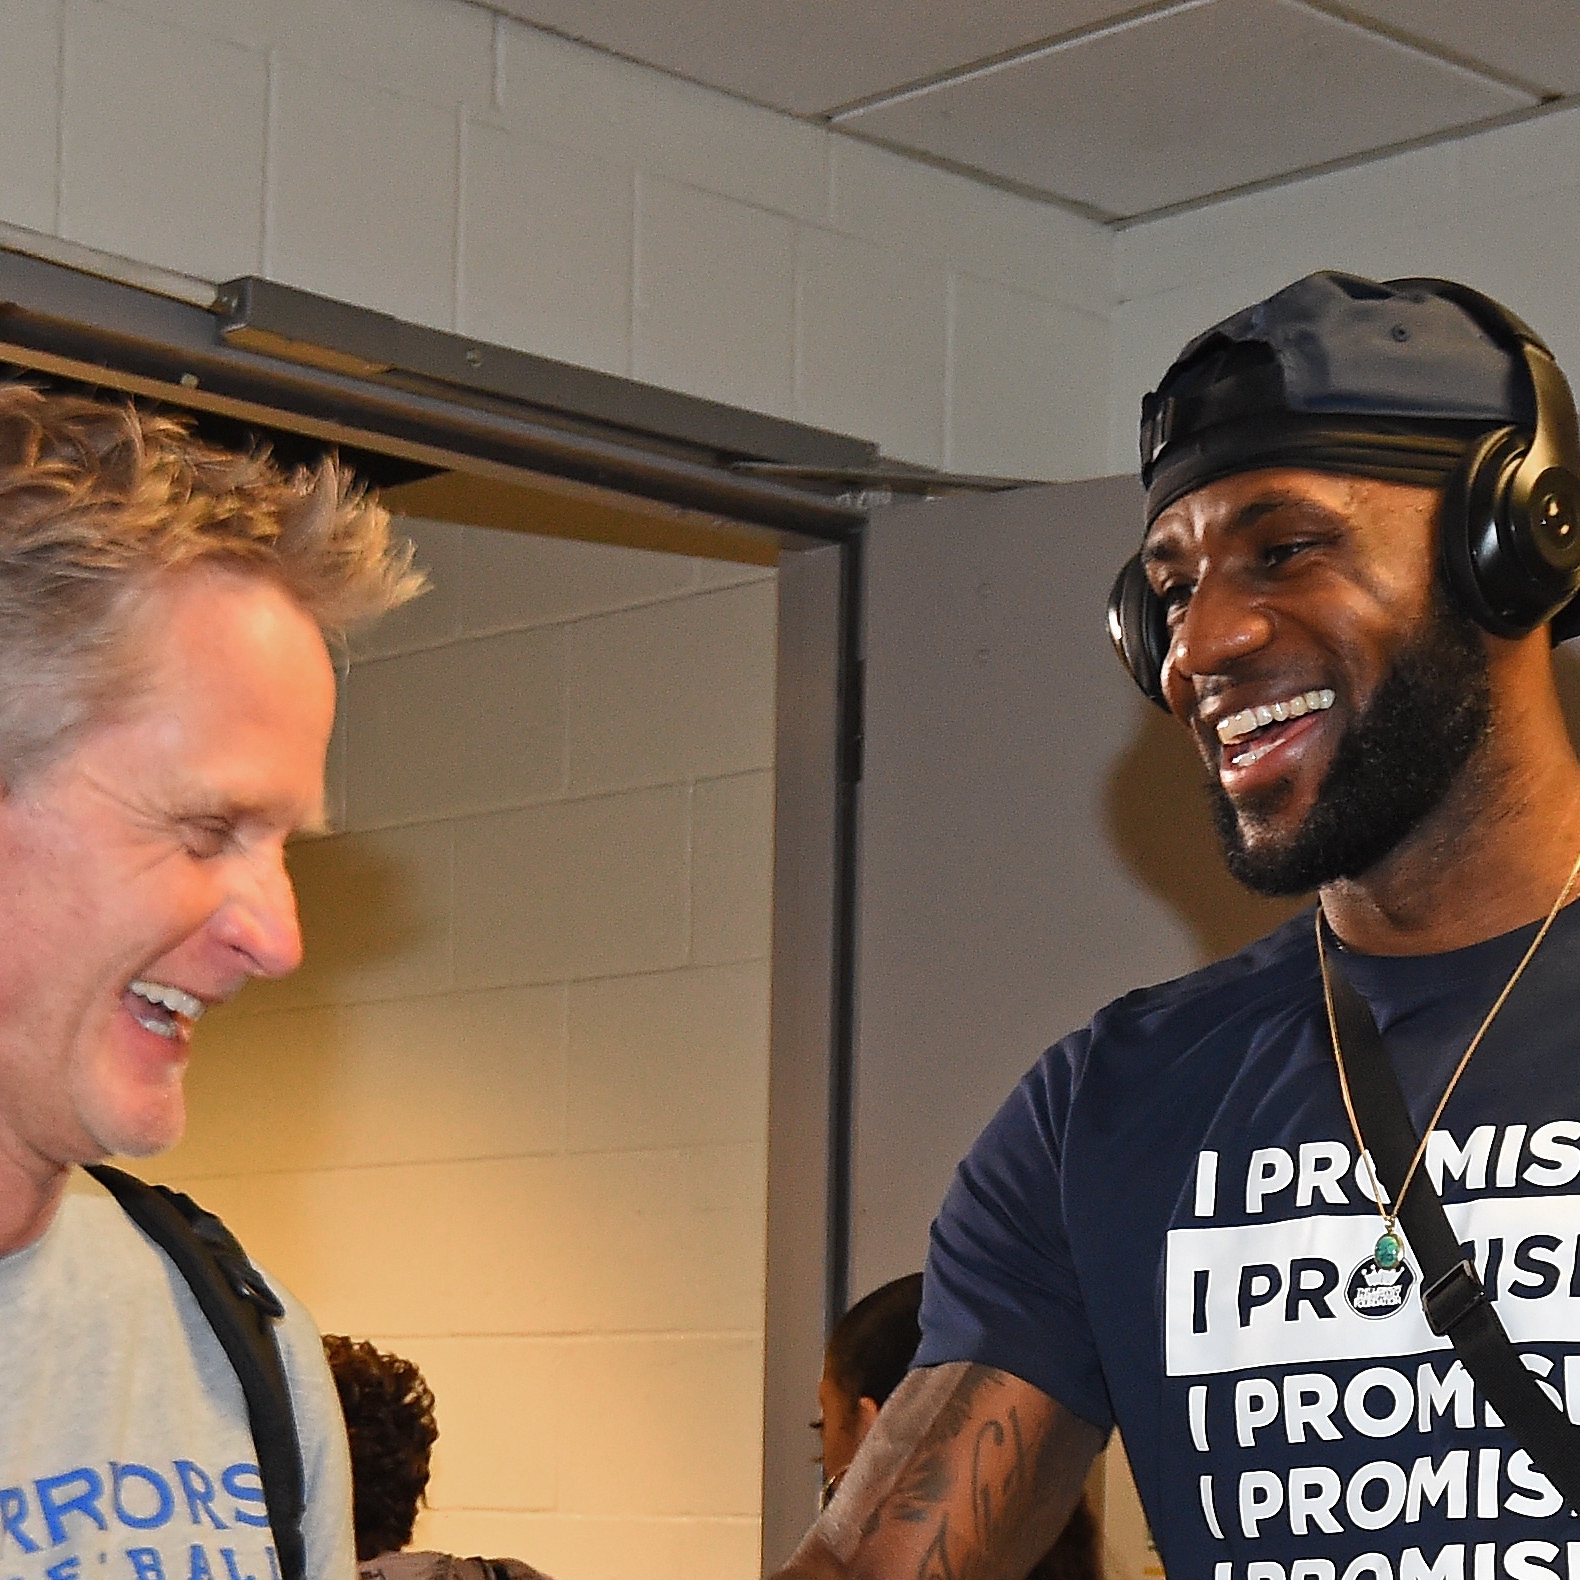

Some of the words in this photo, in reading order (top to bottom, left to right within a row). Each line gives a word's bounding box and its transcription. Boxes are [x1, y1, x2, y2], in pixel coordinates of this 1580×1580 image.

[1194, 1150, 1218, 1217] I
[1192, 1269, 1210, 1334] I
[1188, 1385, 1210, 1452] I
[1199, 1474, 1225, 1540] I
